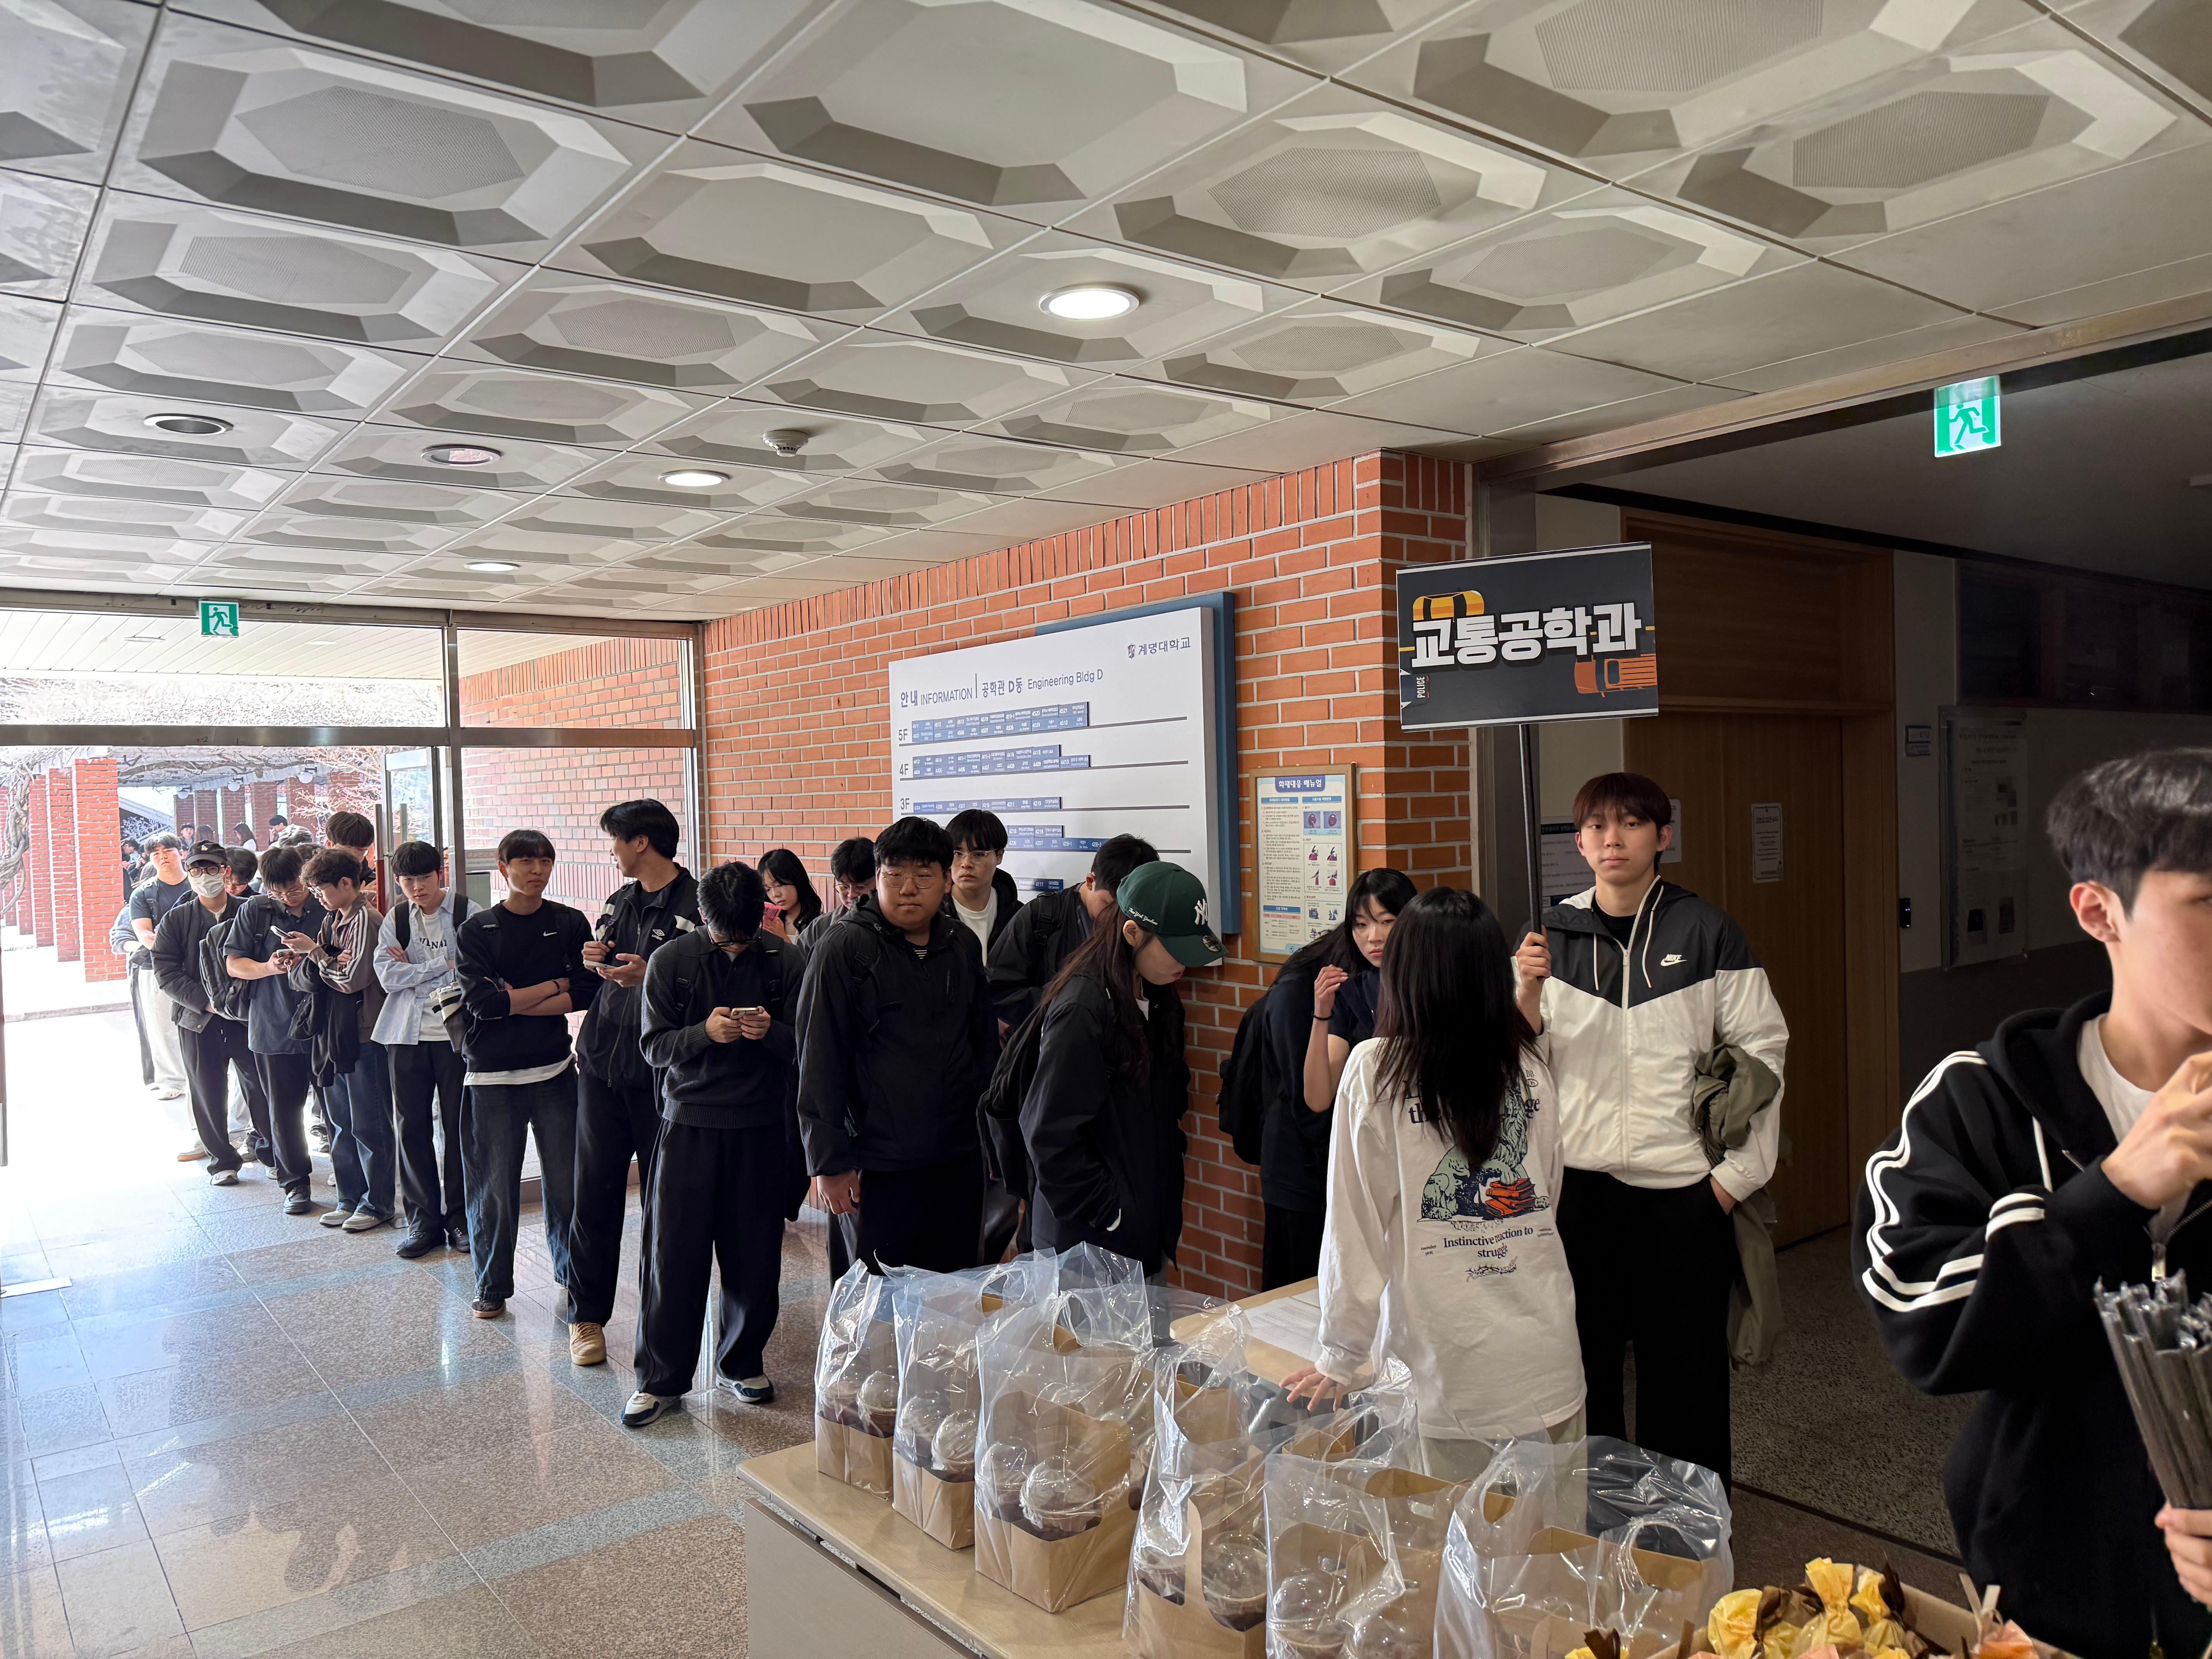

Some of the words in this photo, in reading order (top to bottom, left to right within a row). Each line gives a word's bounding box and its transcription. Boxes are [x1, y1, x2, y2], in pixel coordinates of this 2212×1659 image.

[1412, 602, 1641, 667] 교통공학과
[1138, 637, 1191, 656] 계명대학교
[982, 680, 1005, 698] 공학관
[1008, 677, 1023, 693] D동
[1028, 675, 1073, 690] Engineering
[1076, 671, 1094, 683] Bldg
[1097, 669, 1103, 680] D
[1417, 676, 1425, 698] POLICE
[901, 690, 918, 708] 안내
[921, 687, 972, 705] INFORMATION
[899, 729, 908, 741] 5F
[900, 764, 909, 775] 4F
[1279, 780, 1302, 788] 화재대응
[1304, 779, 1322, 788] 매뉴얼
[900, 798, 910, 810] 3F
[1443, 1236, 1494, 1248] Instinctive
[1494, 1228, 1522, 1243] reaction
[1525, 1226, 1534, 1235] to
